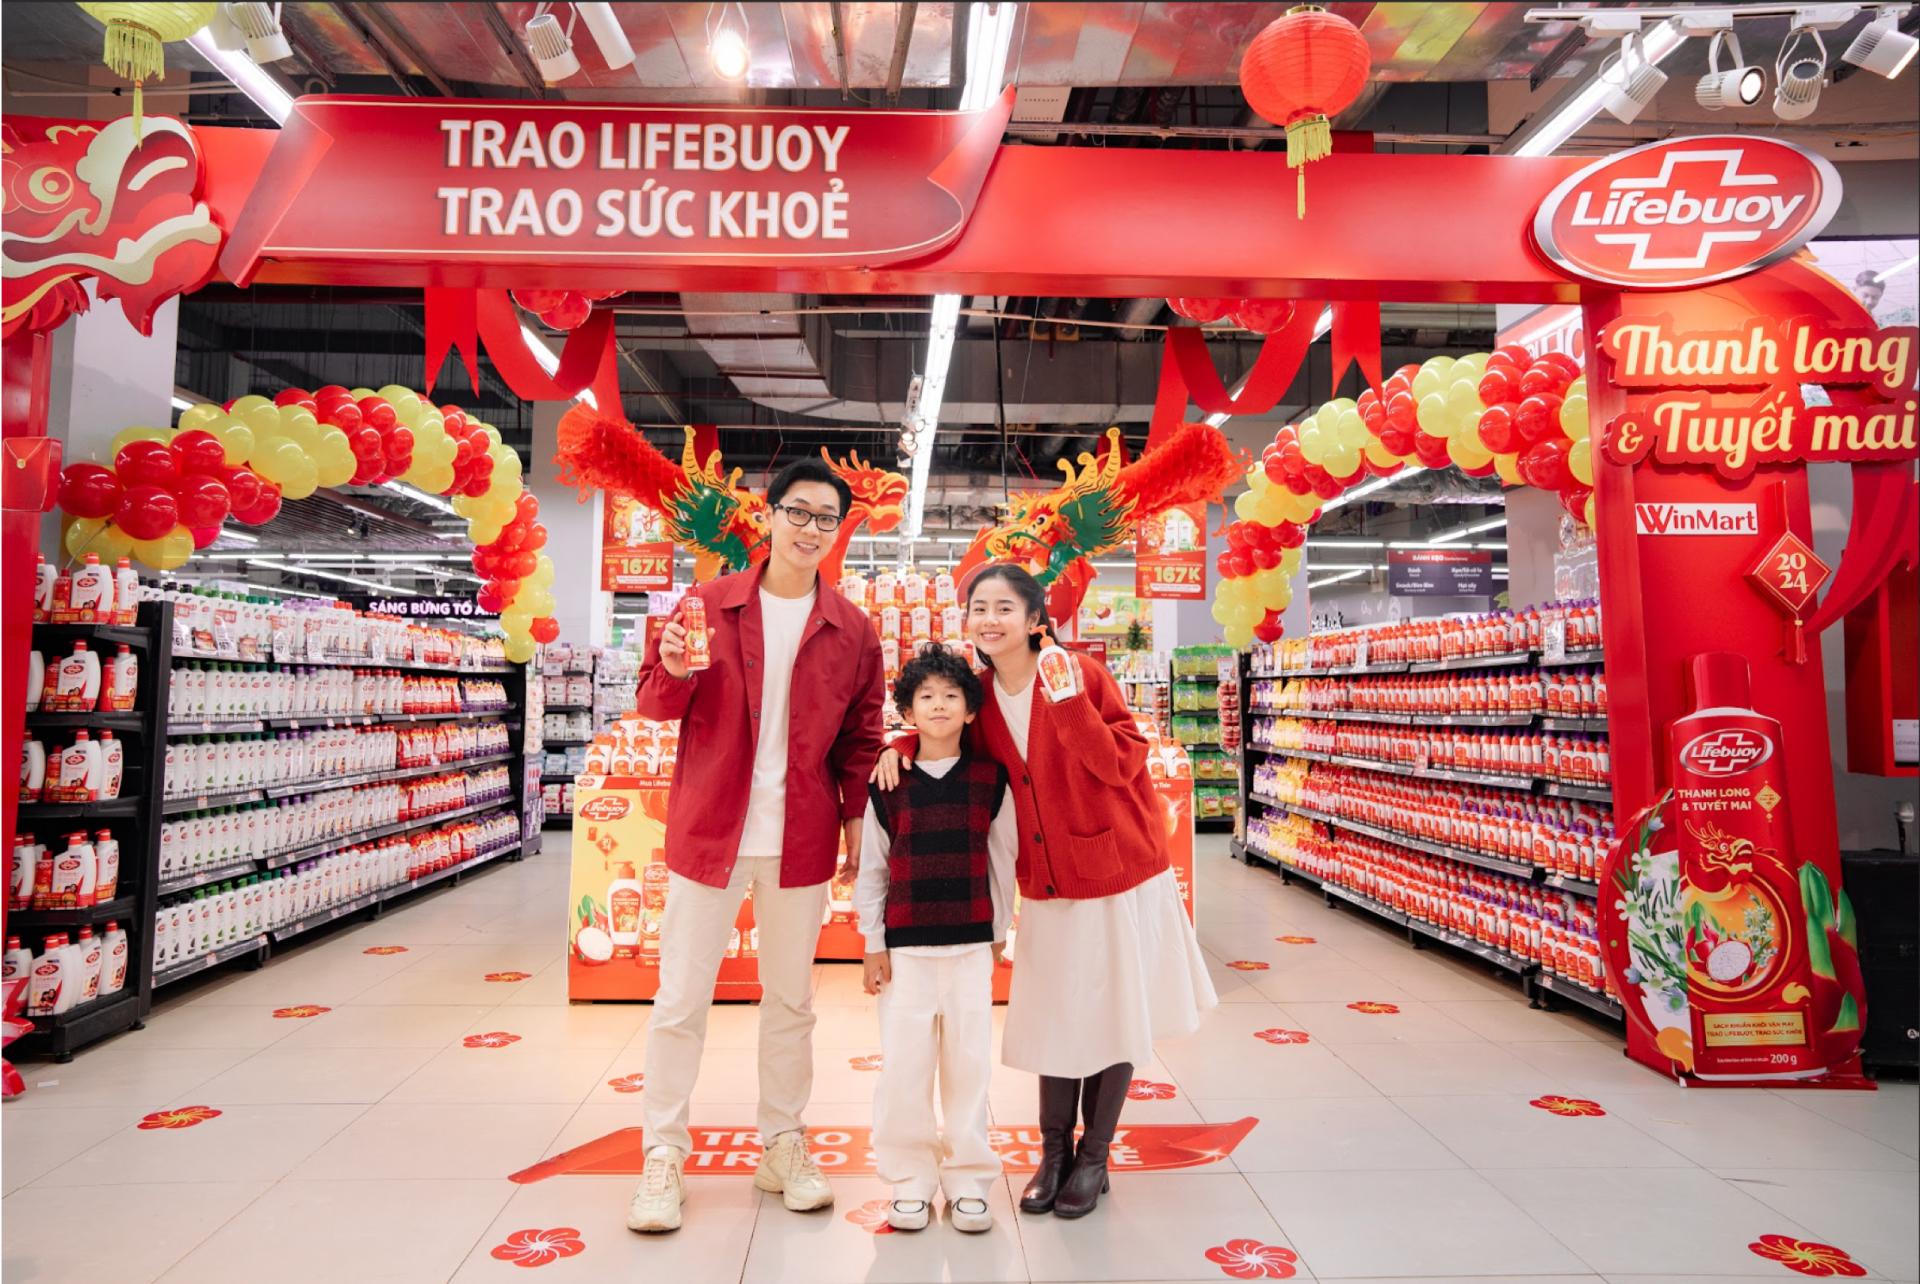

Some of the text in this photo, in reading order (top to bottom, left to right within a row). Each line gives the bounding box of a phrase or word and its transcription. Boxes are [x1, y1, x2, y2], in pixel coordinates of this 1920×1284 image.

[440, 119, 851, 172] TRAO LIFEBUOY
[437, 178, 850, 239] TRAO SỨC KHOẺ
[1571, 189, 1806, 230] Lifebuoy
[1612, 324, 1780, 376] Thanh
[1793, 325, 1911, 388] long
[1617, 391, 1918, 469] & Tuyết mai
[1636, 504, 1757, 534] WinMart
[1776, 552, 1807, 571] 20
[1778, 571, 1810, 594] 24
[369, 599, 407, 614] SÁNG
[411, 600, 450, 615] BỪNG
[1690, 746, 1762, 760] Lifebuoy
[1678, 788, 1751, 798] THANH LONG
[585, 804, 627, 813] Lifebuoy
[1682, 799, 1751, 811] & TUYẾT MAI
[1770, 1053, 1789, 1064] 200
[1790, 1055, 1797, 1065] g
[700, 1131, 852, 1146] TRO
[691, 1151, 849, 1167] TRO
